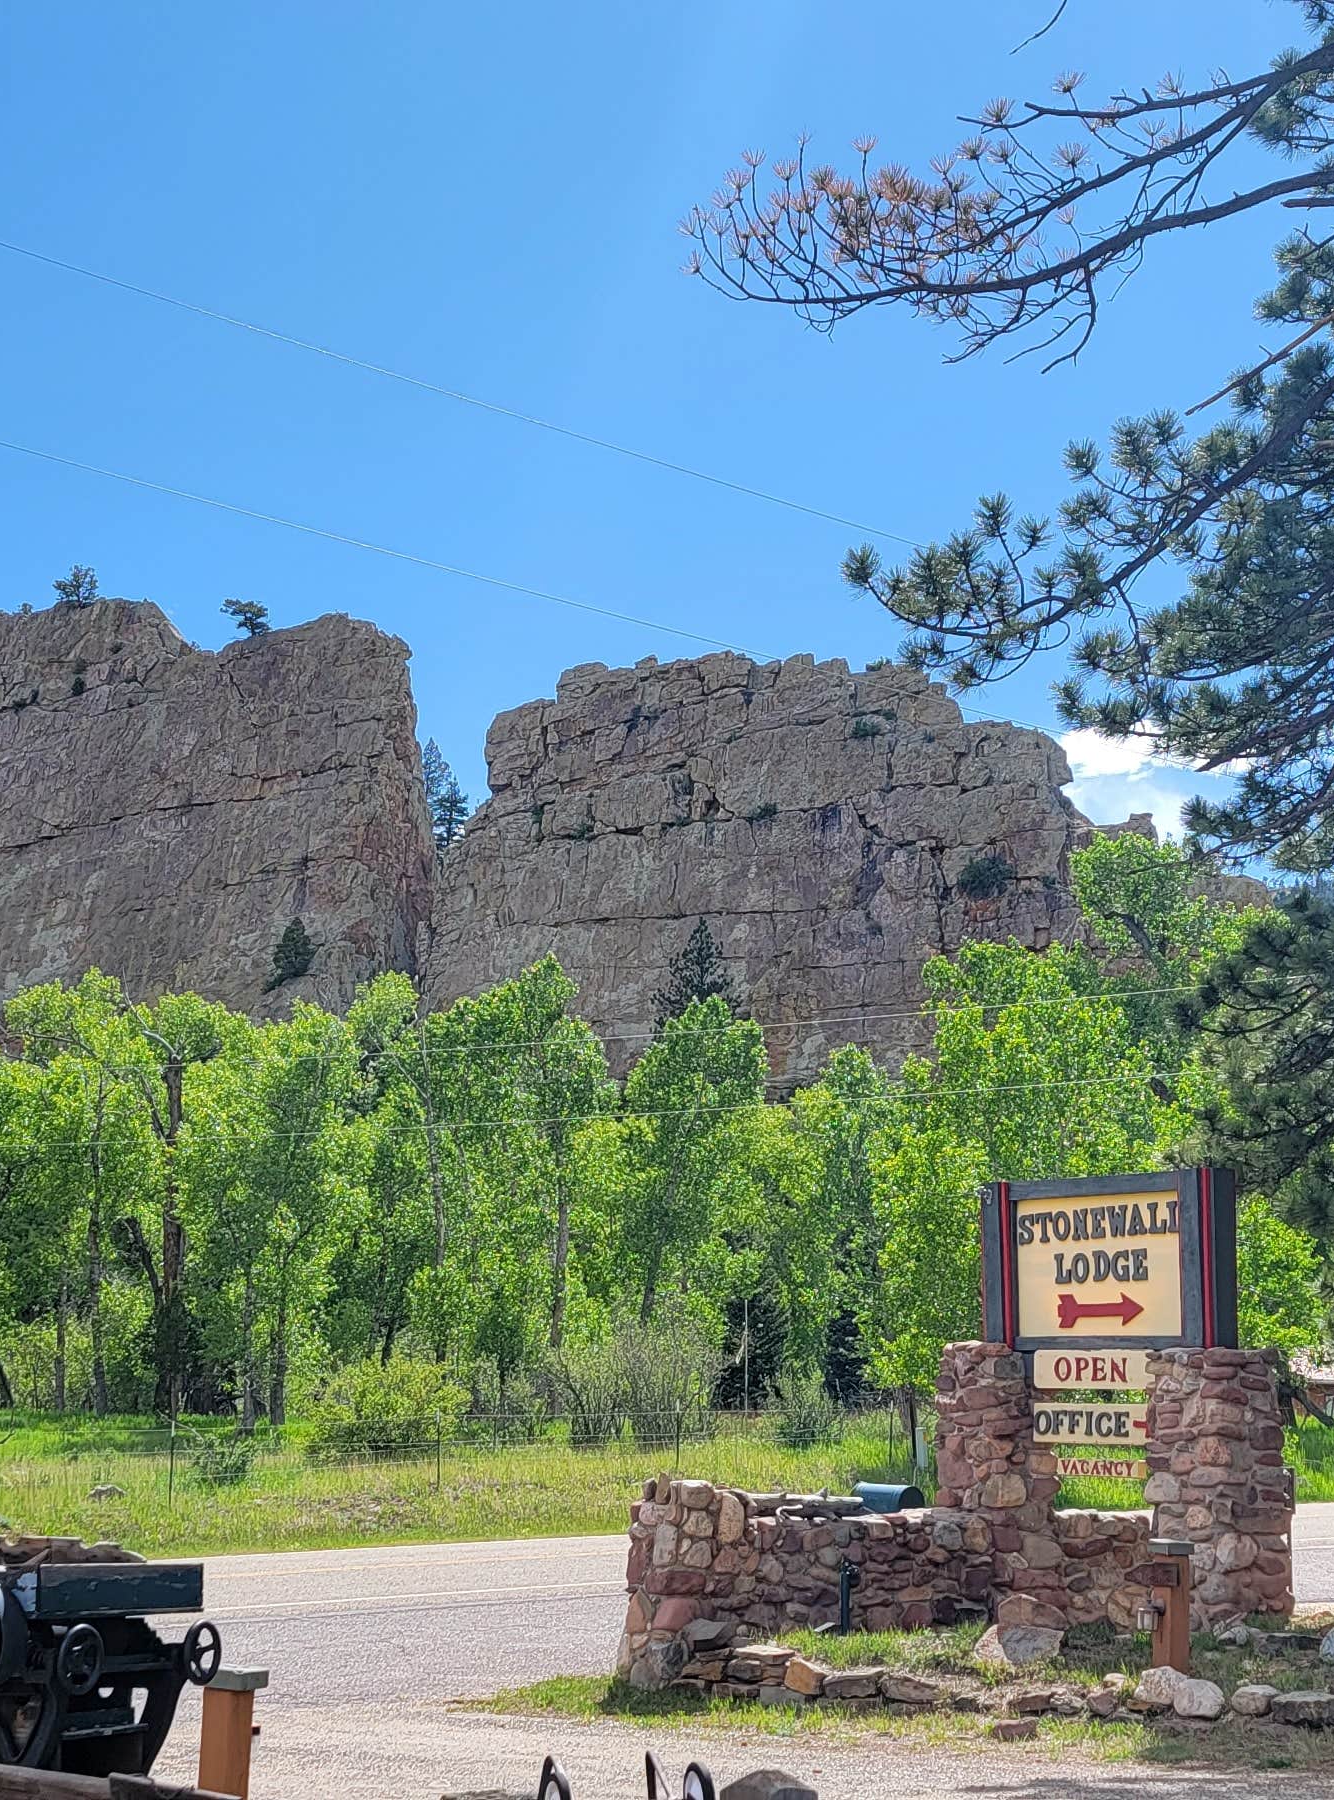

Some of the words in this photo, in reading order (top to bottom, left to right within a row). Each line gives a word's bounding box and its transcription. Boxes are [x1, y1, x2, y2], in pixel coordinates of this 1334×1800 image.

[1054, 1248, 1148, 1284] LODGE
[1053, 1356, 1128, 1383] OPEN
[1034, 1410, 1130, 1437] OFFICE
[1061, 1460, 1135, 1476] VACANCY
